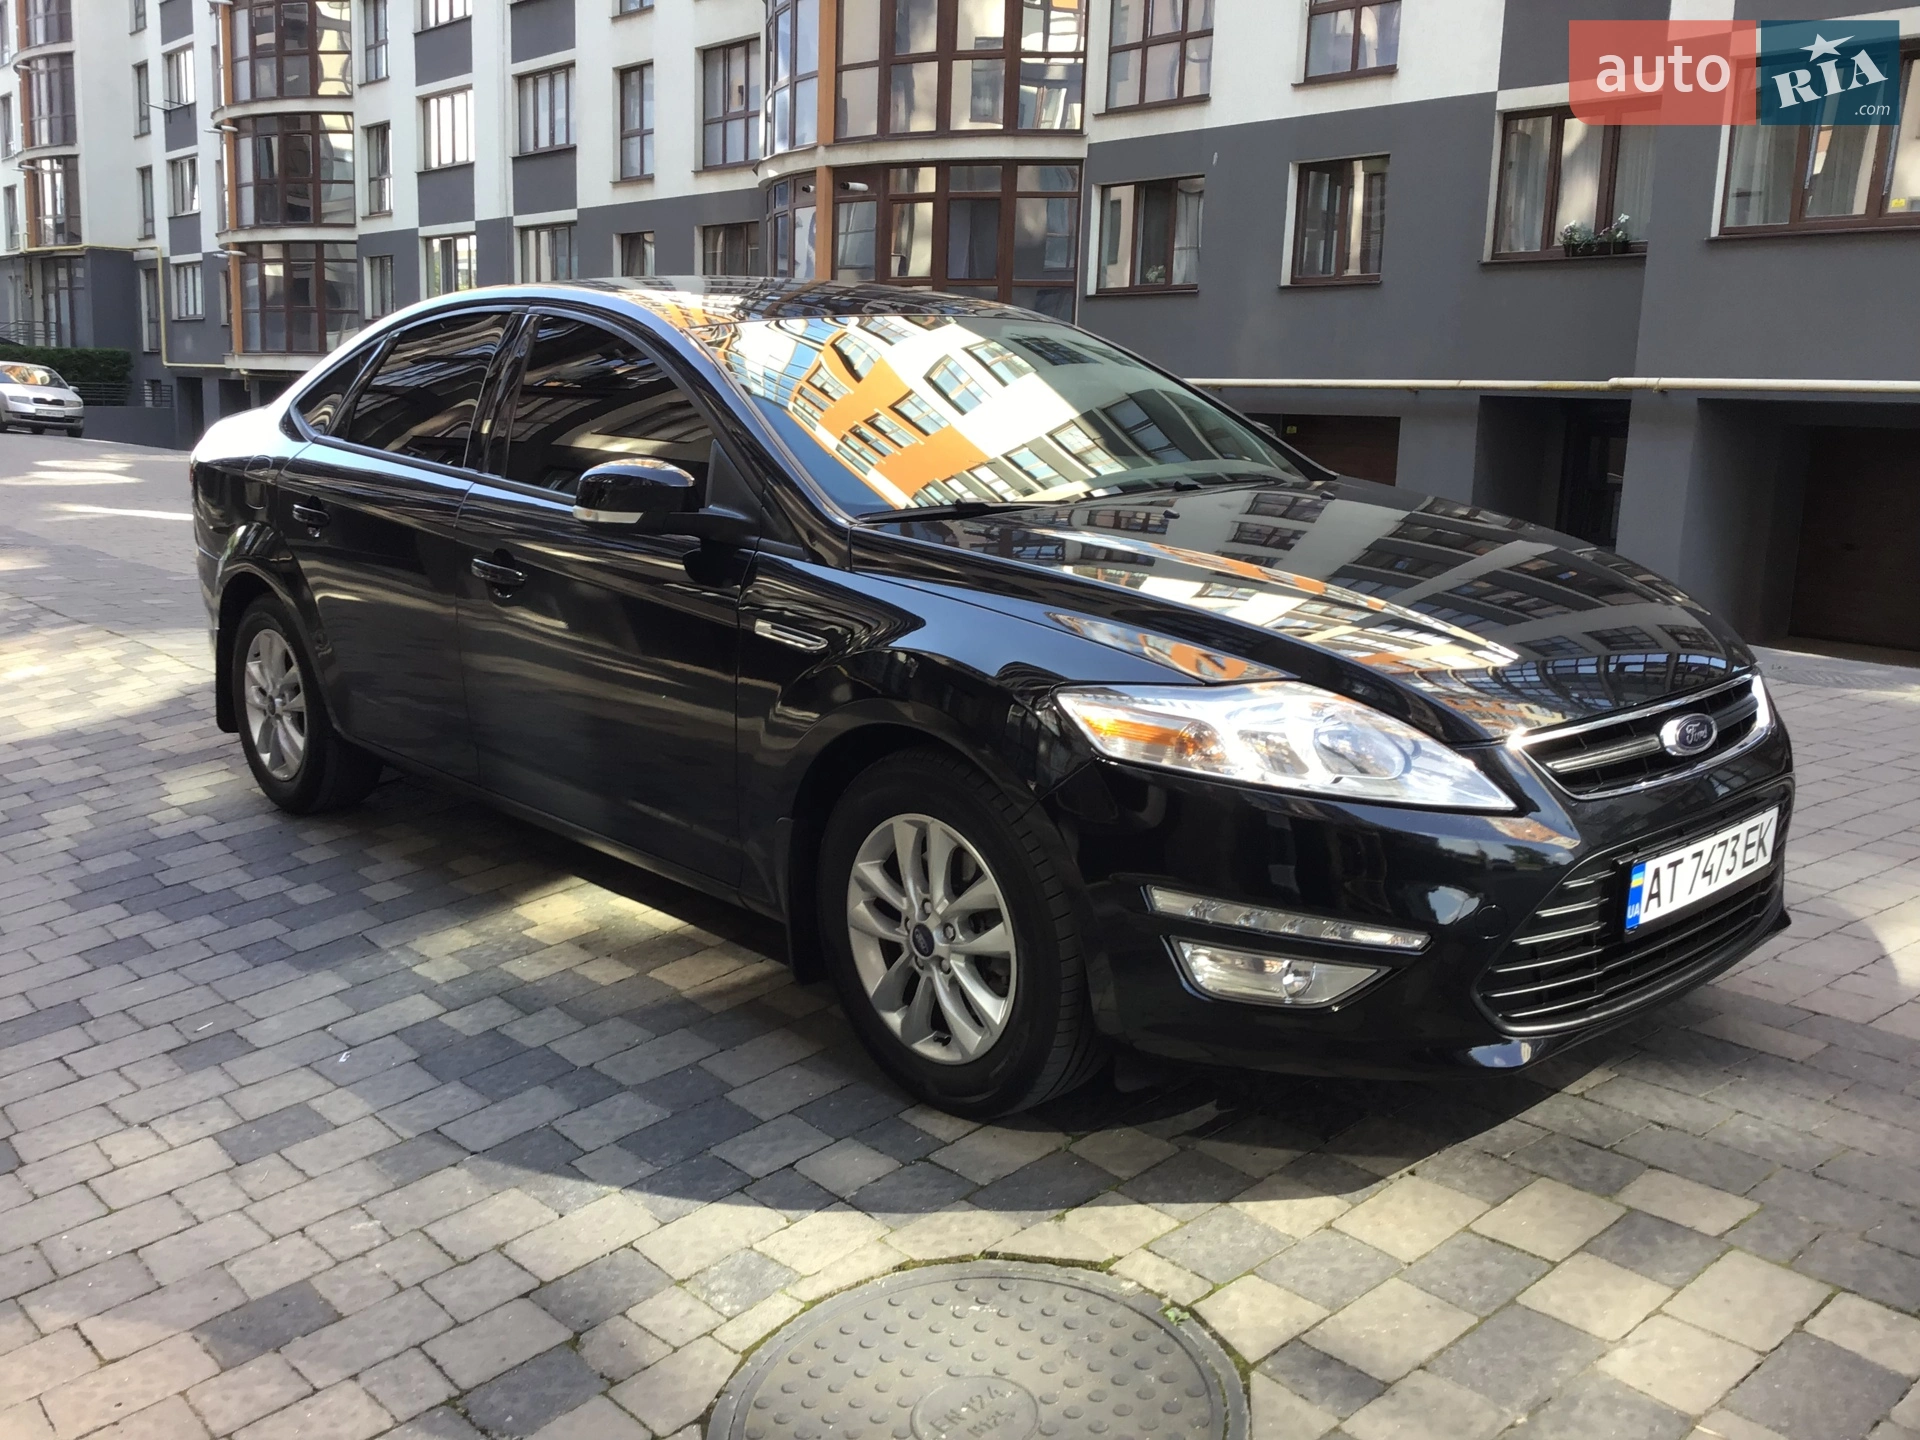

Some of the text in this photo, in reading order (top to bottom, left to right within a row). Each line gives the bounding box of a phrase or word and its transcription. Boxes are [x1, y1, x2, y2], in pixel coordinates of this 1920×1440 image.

[1685, 722, 1708, 745] Ford
[1644, 817, 1773, 914] AT 7473 EK
[1627, 902, 1640, 919] UA
[930, 1408, 967, 1433] EN
